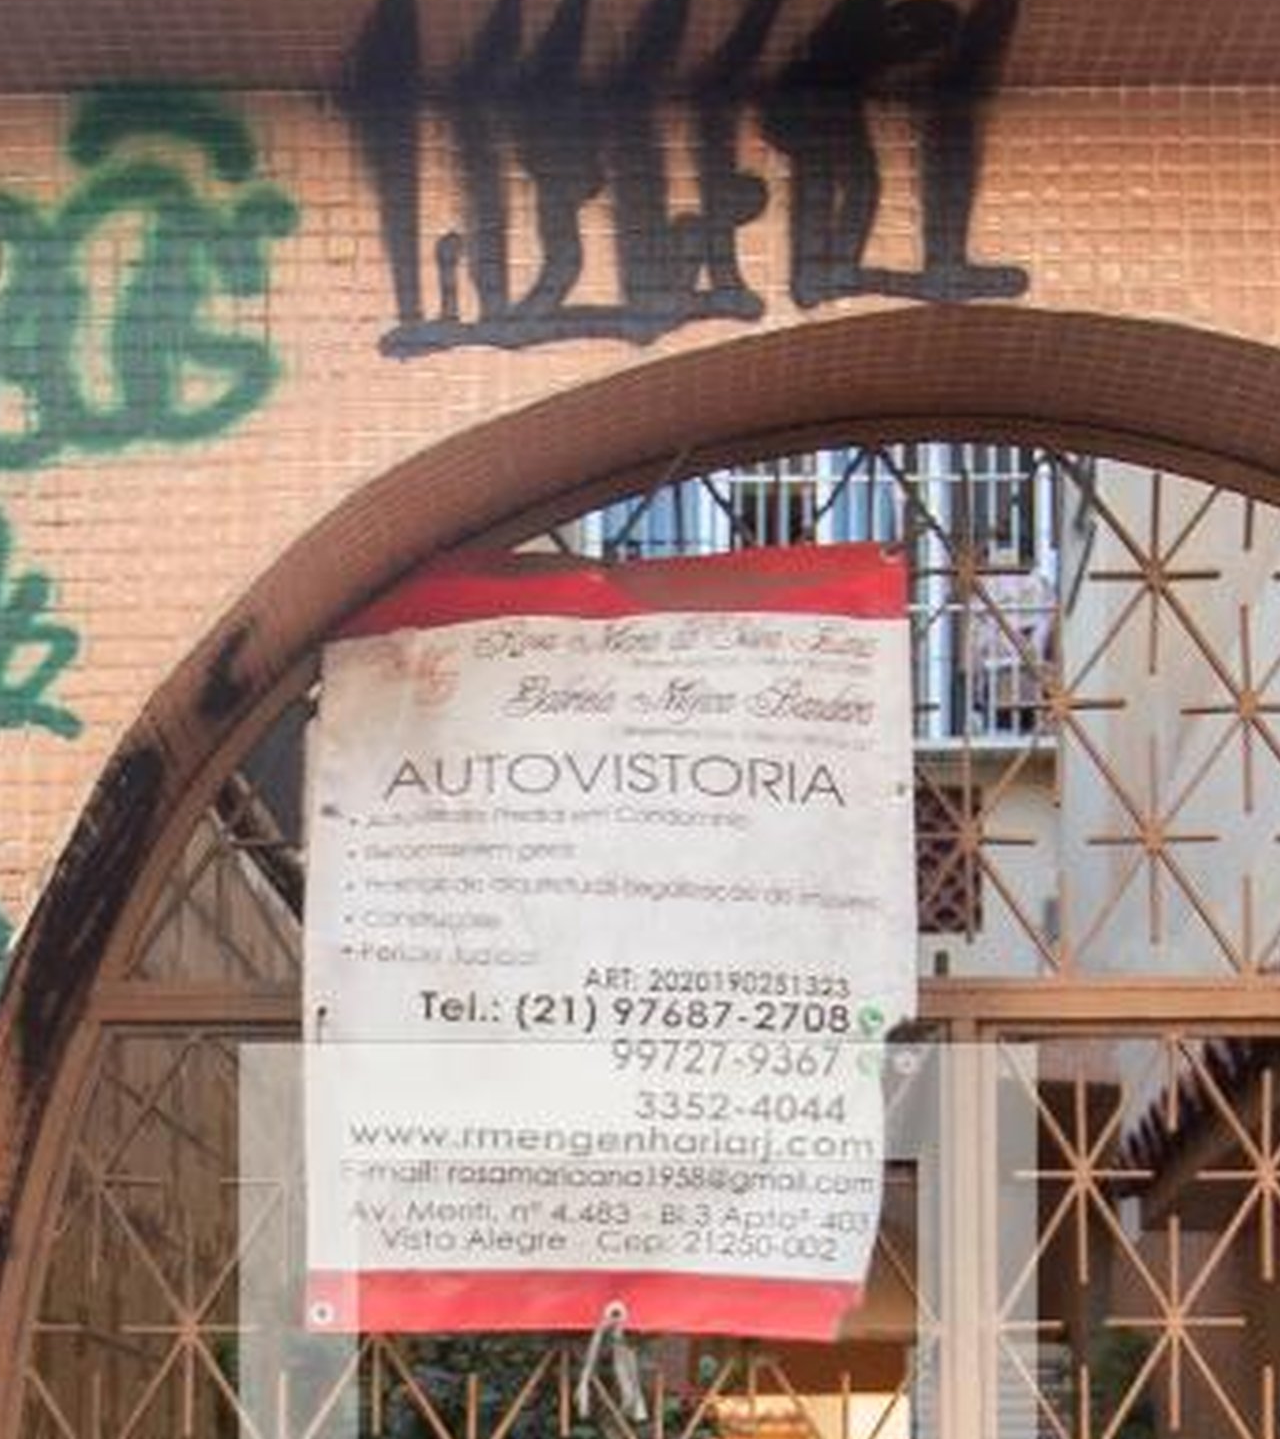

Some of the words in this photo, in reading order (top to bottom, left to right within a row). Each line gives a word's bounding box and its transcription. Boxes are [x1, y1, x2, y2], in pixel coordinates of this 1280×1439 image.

[382, 752, 846, 808] AUTOVISTORIA
[419, 990, 500, 1024] Tel.:
[516, 995, 598, 1033] (21)
[612, 997, 851, 1034] 97687-2708
[610, 1039, 842, 1077] 99727-9367
[635, 1091, 847, 1124] 3352-4044
[350, 1123, 874, 1163] www.rmengenhariarj.com
